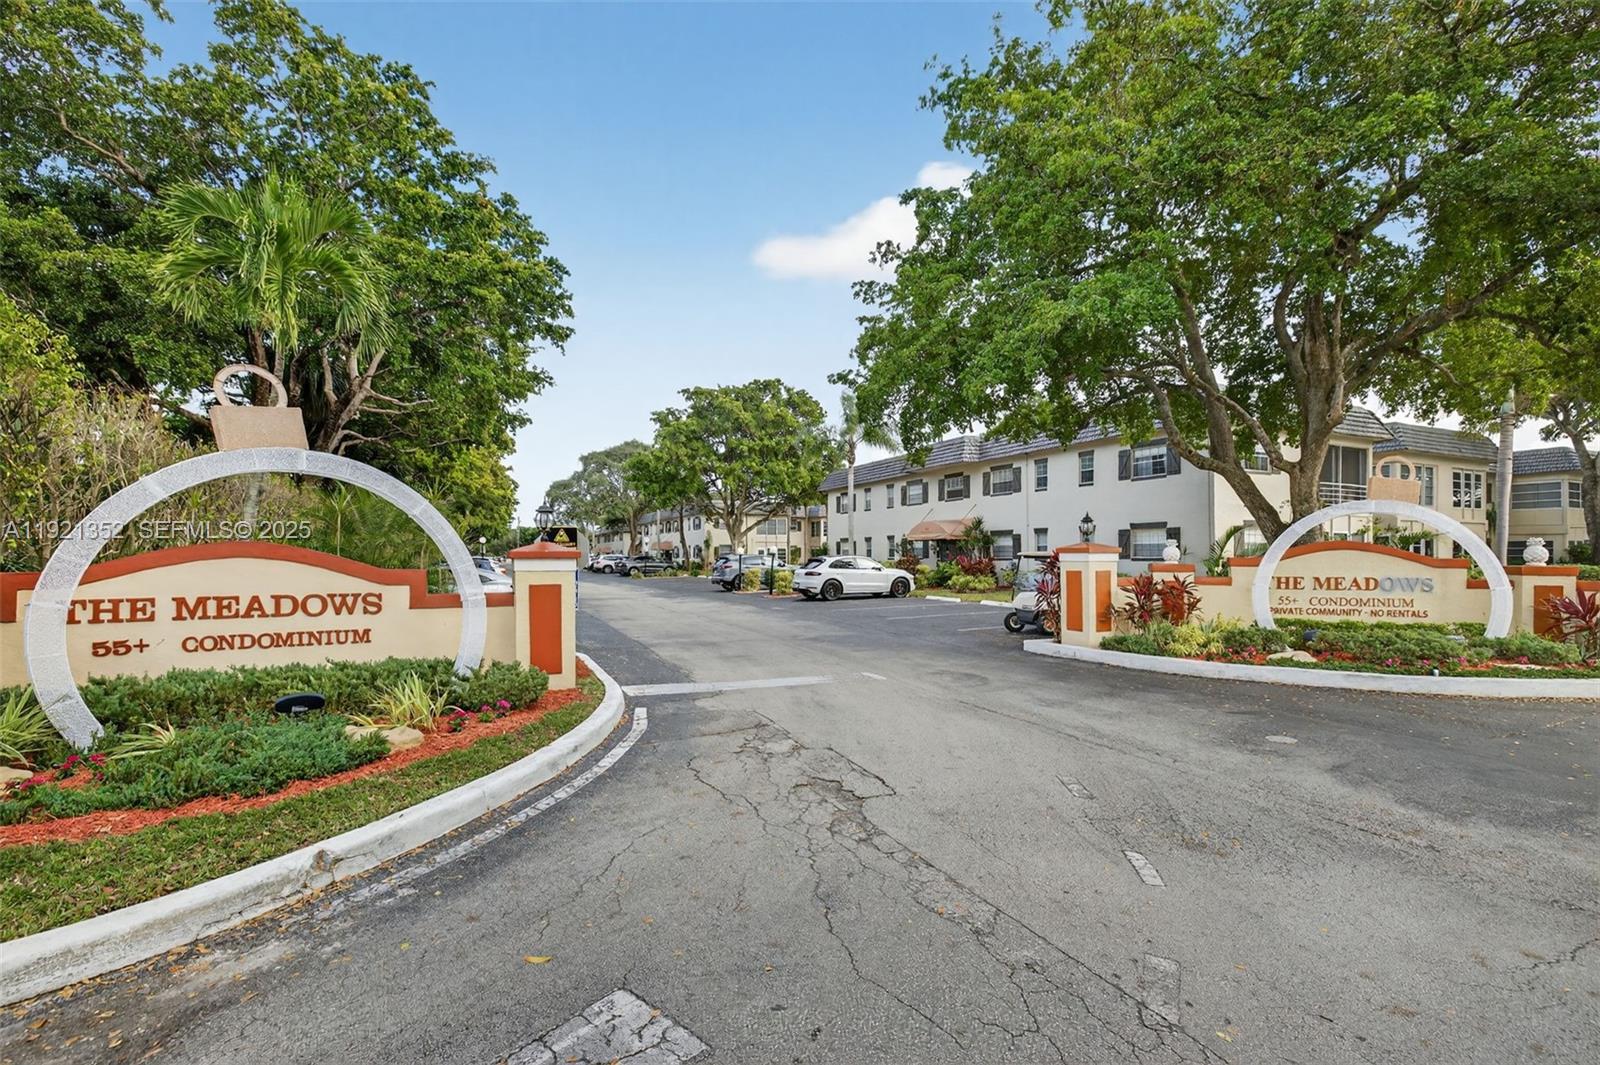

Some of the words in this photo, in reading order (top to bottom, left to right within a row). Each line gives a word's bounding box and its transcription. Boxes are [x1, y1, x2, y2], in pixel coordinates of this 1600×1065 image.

[1269, 575, 1305, 591] HE
[1312, 575, 1434, 593] MEADOWS
[66, 598, 156, 625] THE
[171, 592, 383, 621] MEADOWS
[1278, 595, 1299, 606] 55+
[1309, 596, 1415, 608] CONDOMINIUM
[1305, 607, 1362, 616] COMMUNITY
[1370, 609, 1385, 618] NO
[1386, 609, 1429, 619] RENTALS
[91, 638, 150, 658] 55+
[181, 628, 372, 653] CONDOMINIUM
